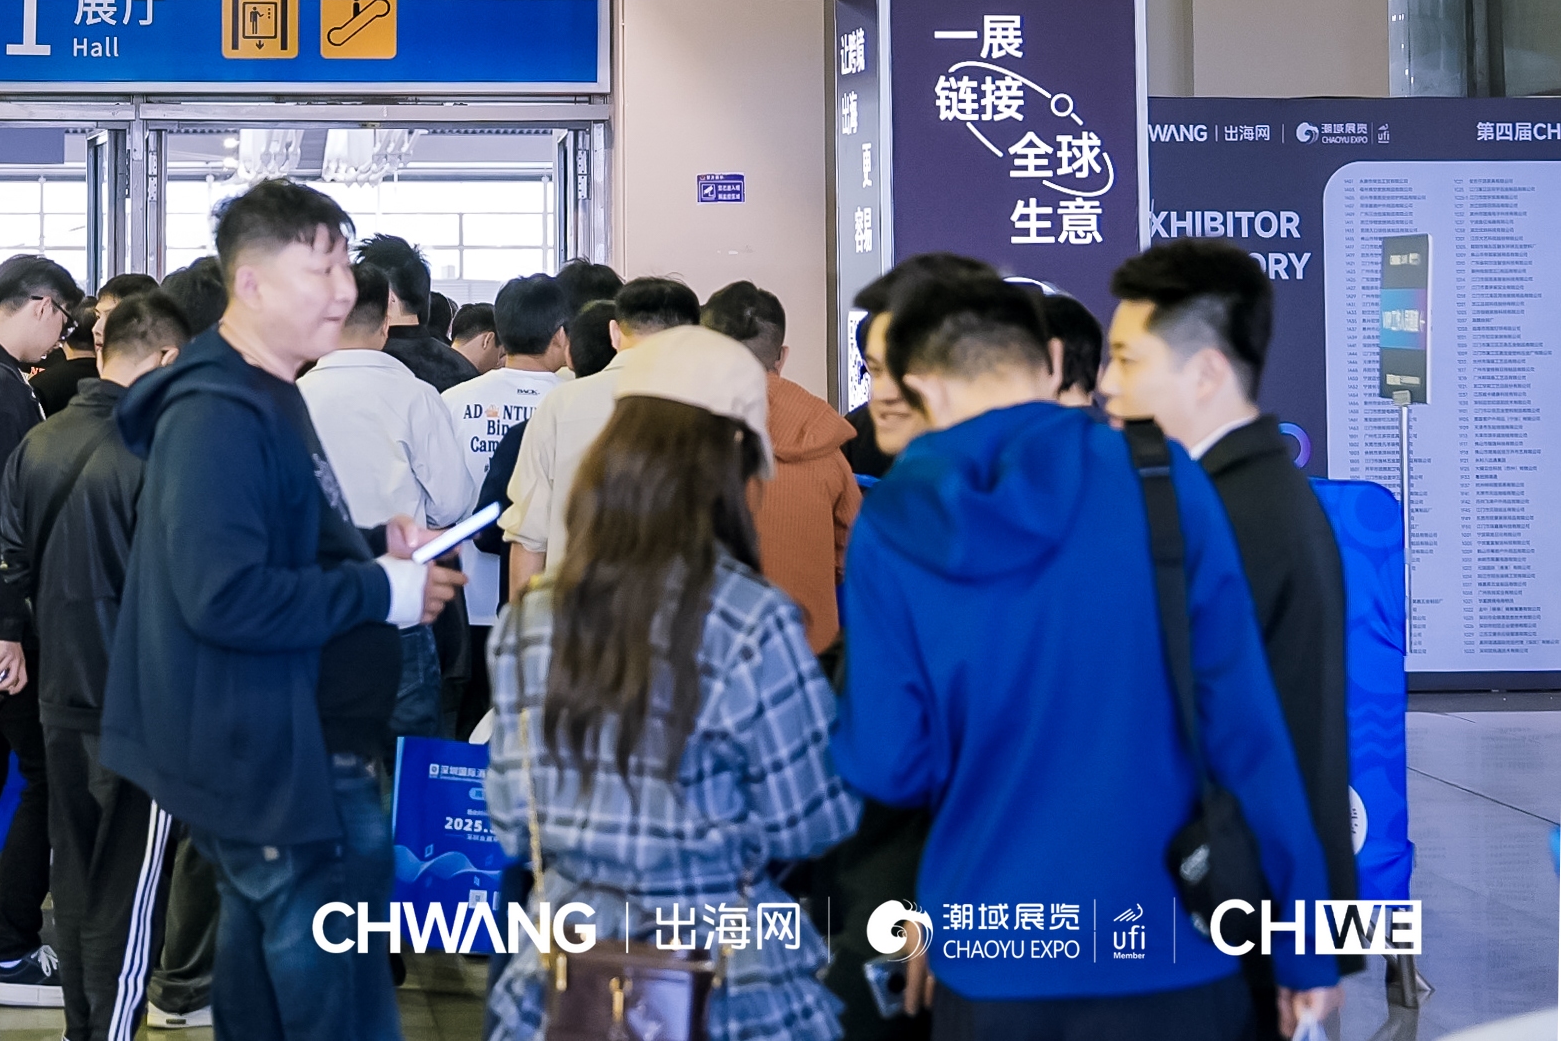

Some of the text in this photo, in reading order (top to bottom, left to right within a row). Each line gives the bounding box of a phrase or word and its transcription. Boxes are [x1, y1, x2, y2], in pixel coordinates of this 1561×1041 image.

[73, 38, 120, 58] Hall
[934, 15, 1024, 59] 一展
[841, 91, 859, 135] 出海
[934, 76, 1026, 122] 链接
[1224, 125, 1271, 141] 出海网
[1321, 123, 1368, 134] 潮域展览
[1322, 135, 1368, 144] CHAOYU EXPO
[862, 142, 873, 188] 更
[1007, 131, 1102, 179] 全球
[854, 206, 873, 254] 容易
[1009, 197, 1104, 245] 生意
